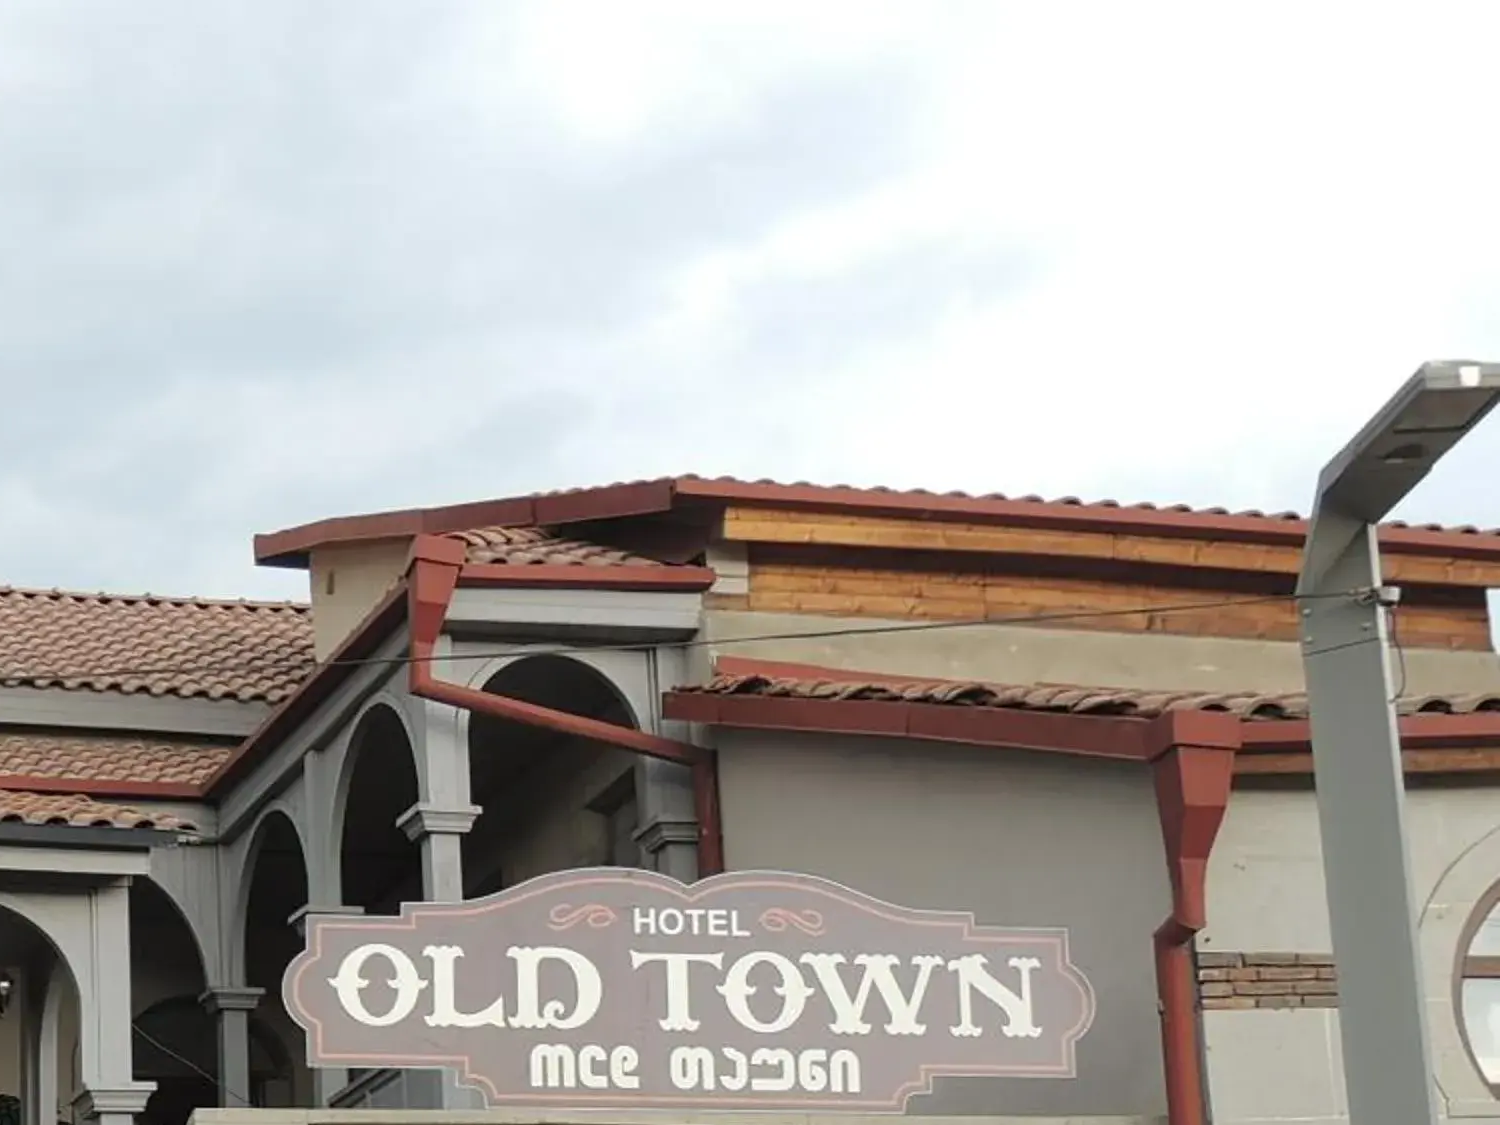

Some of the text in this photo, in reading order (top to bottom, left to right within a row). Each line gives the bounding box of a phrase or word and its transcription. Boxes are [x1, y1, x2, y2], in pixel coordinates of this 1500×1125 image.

[633, 907, 751, 937] HOTEL
[328, 944, 1043, 1038] OLD TOWN
